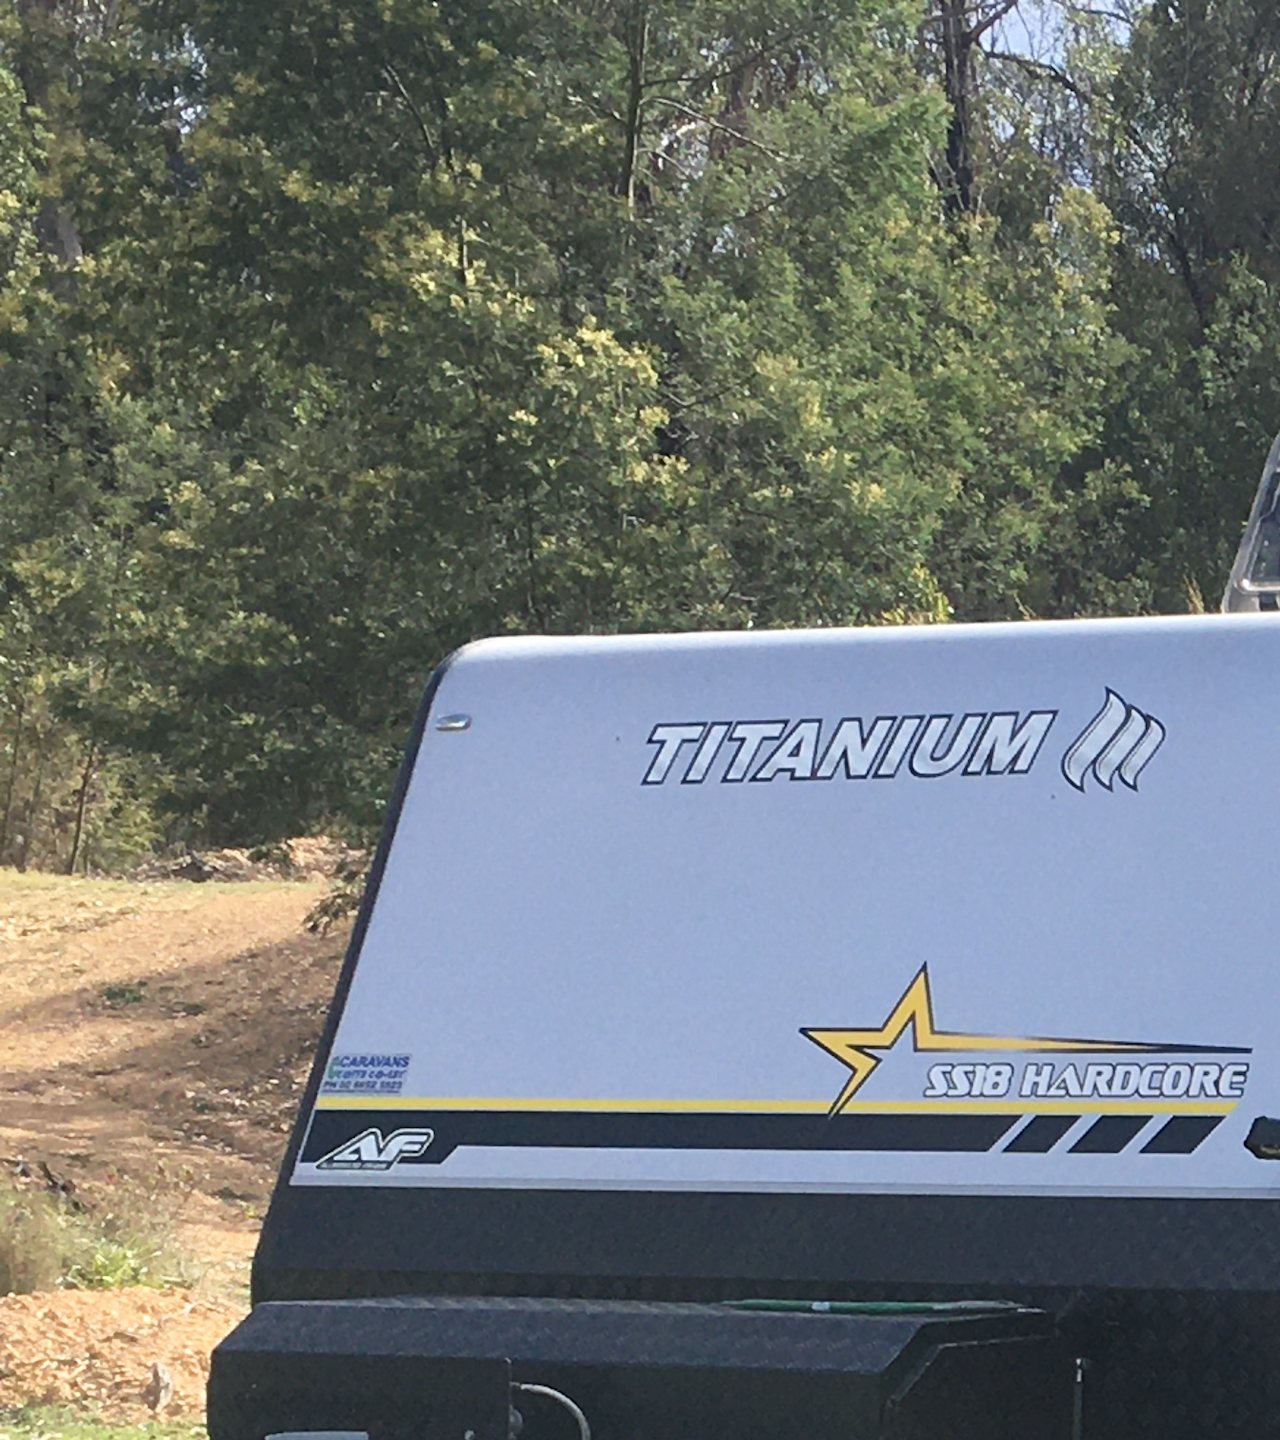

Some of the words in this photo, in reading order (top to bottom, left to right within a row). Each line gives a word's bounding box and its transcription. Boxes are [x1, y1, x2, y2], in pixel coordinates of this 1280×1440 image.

[641, 709, 1059, 786] TITANIUM
[340, 1056, 410, 1068] CARAVANS
[924, 1063, 1014, 1098] SS18
[1019, 1063, 1250, 1098] HARDCORE
